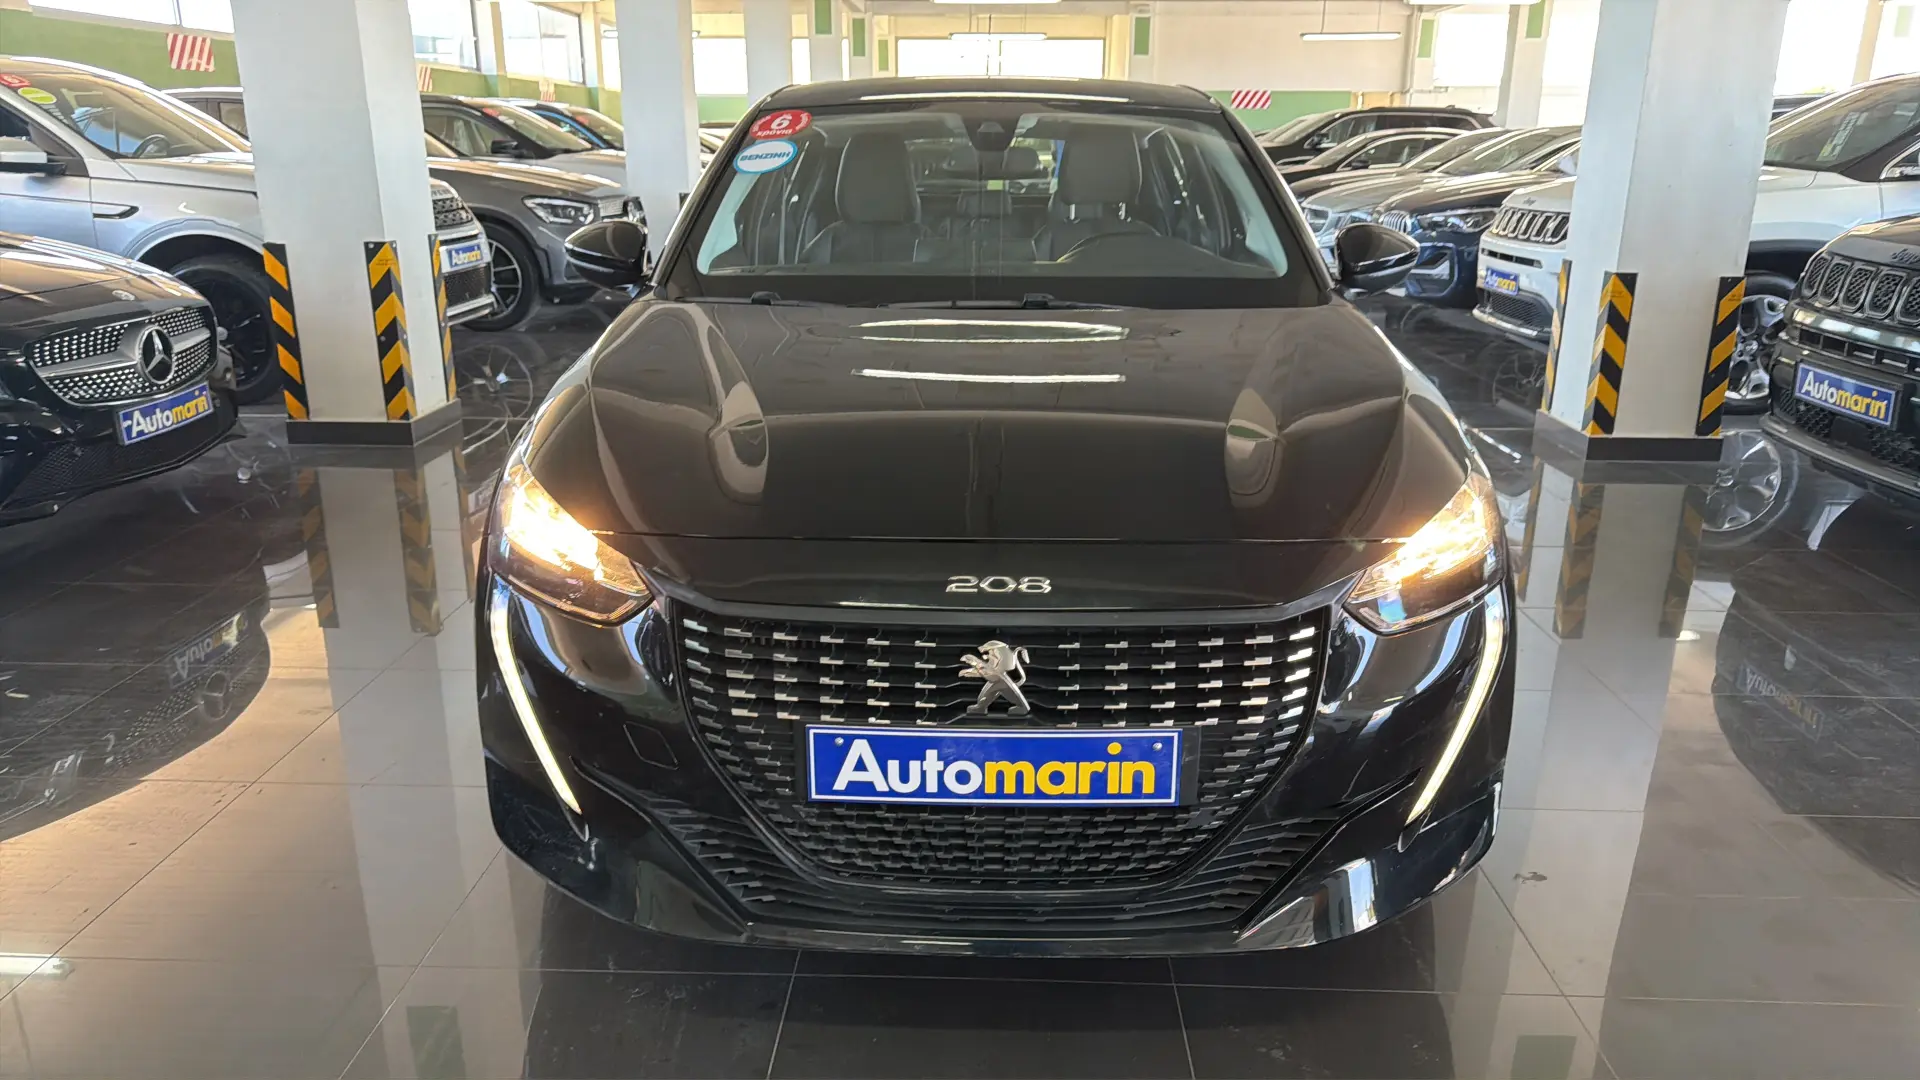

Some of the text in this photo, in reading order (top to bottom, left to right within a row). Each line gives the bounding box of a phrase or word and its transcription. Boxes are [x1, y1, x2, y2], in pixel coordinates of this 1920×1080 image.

[770, 113, 793, 130] 6
[130, 389, 208, 438] Automarin
[1801, 370, 1888, 420] Automarin
[945, 575, 1052, 594] 208
[832, 738, 1156, 795] Automarin
